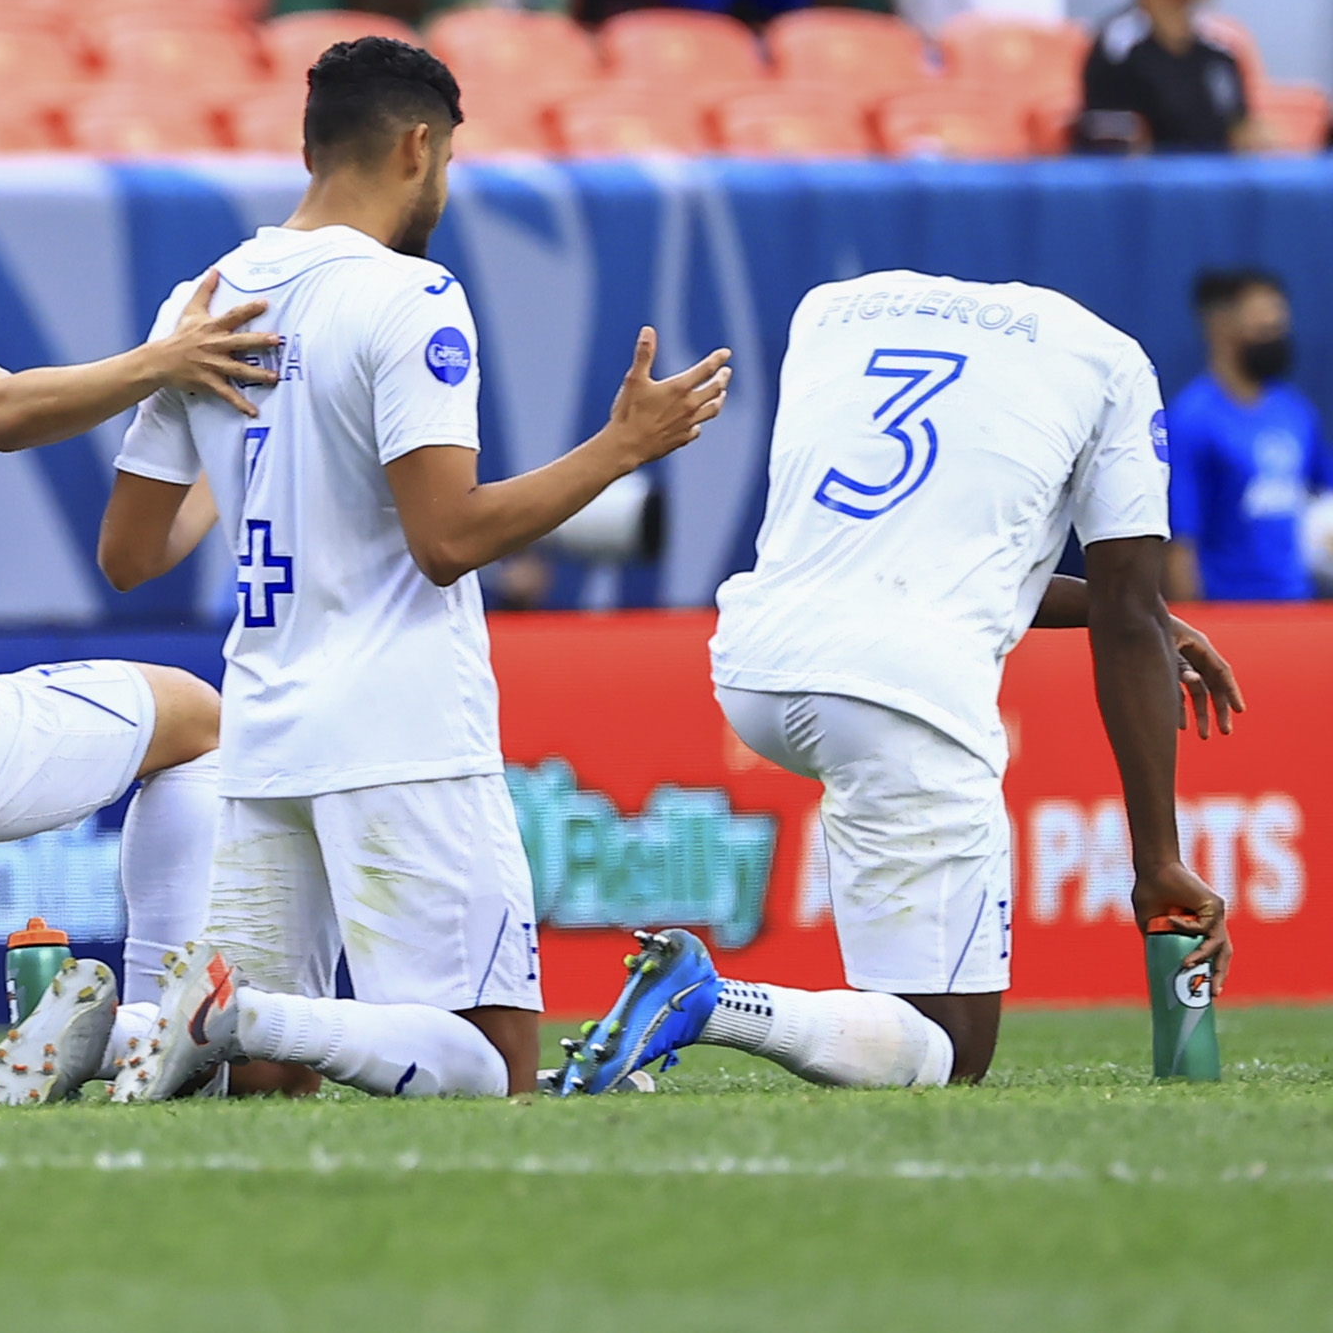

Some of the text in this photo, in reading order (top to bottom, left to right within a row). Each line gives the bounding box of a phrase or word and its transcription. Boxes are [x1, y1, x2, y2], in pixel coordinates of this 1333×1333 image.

[817, 289, 1040, 343] FIGUEROA
[813, 348, 969, 520] 3
[1026, 793, 1308, 924] PATS
